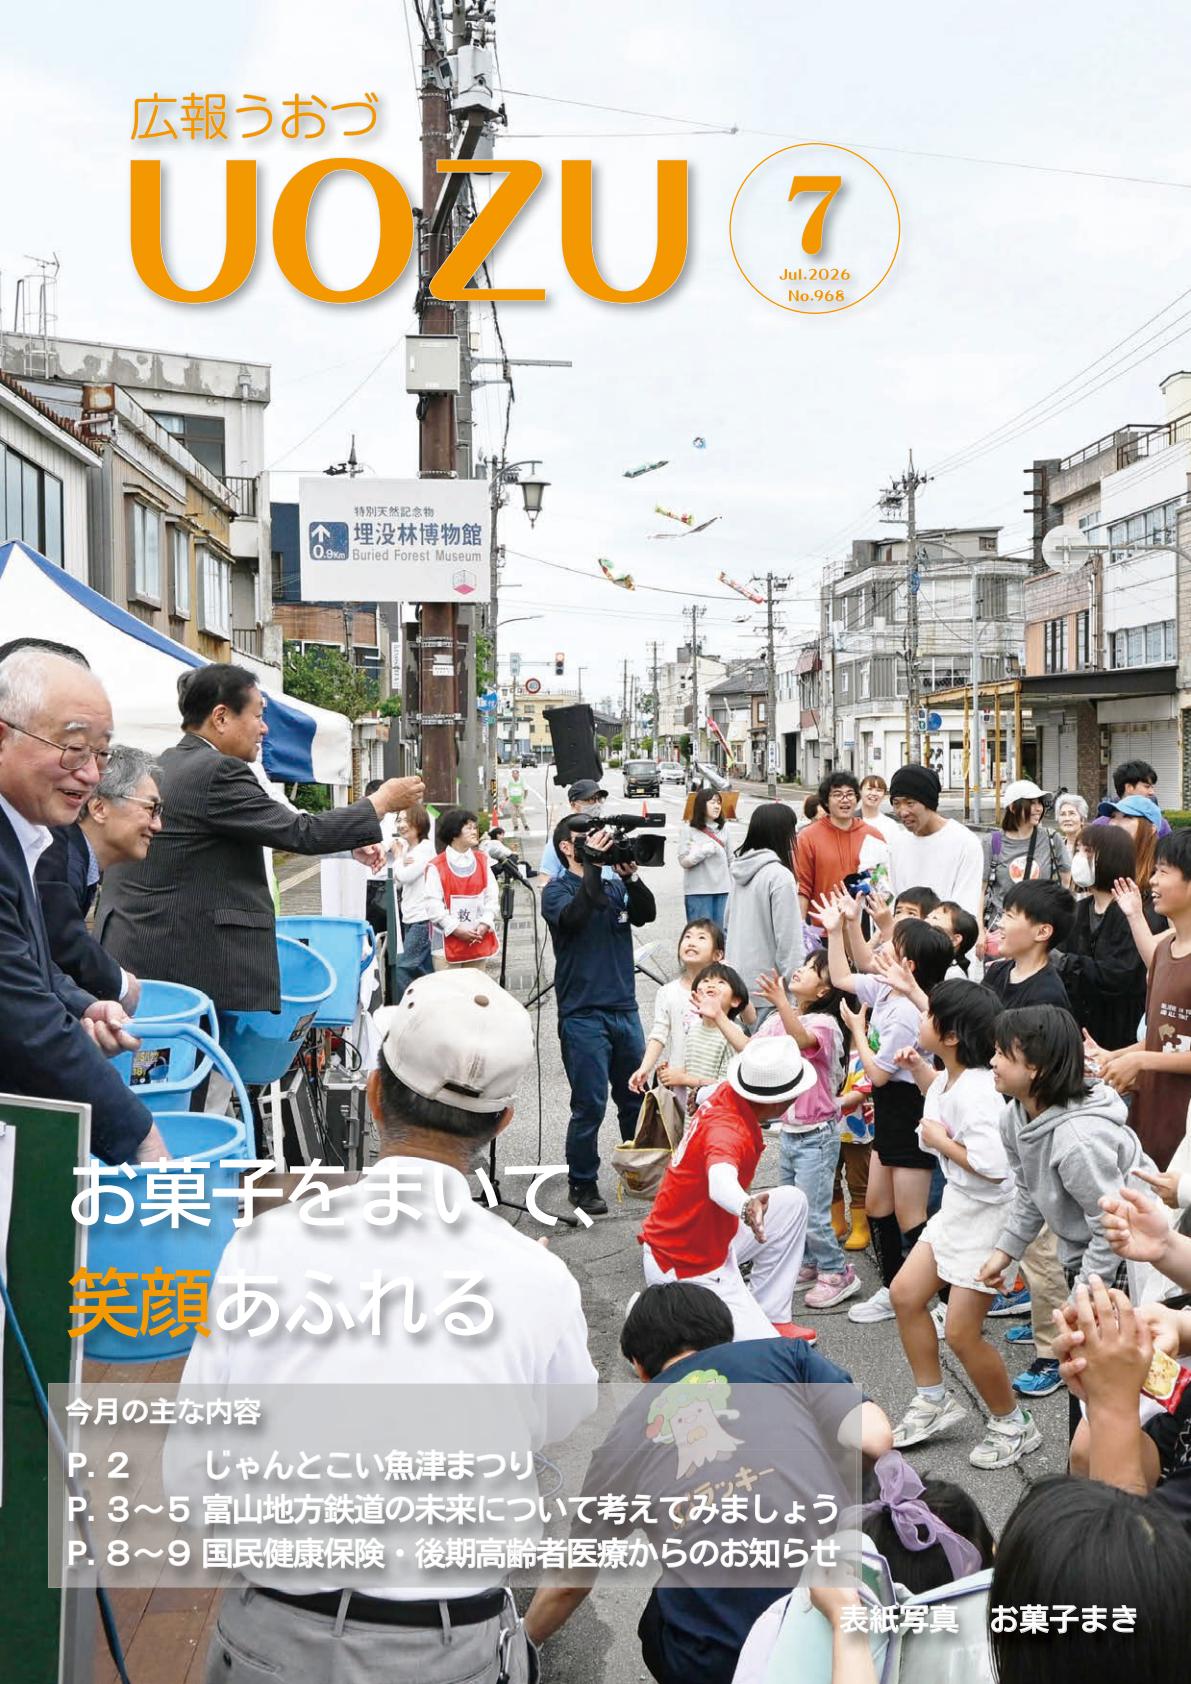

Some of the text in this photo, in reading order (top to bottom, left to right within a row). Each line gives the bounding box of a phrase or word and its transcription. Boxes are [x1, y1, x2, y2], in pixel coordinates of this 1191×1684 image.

[354, 506, 435, 517] 特別天然記念物
[353, 522, 482, 546] 埋没林博物館
[352, 549, 482, 562] Buried Forest Museum
